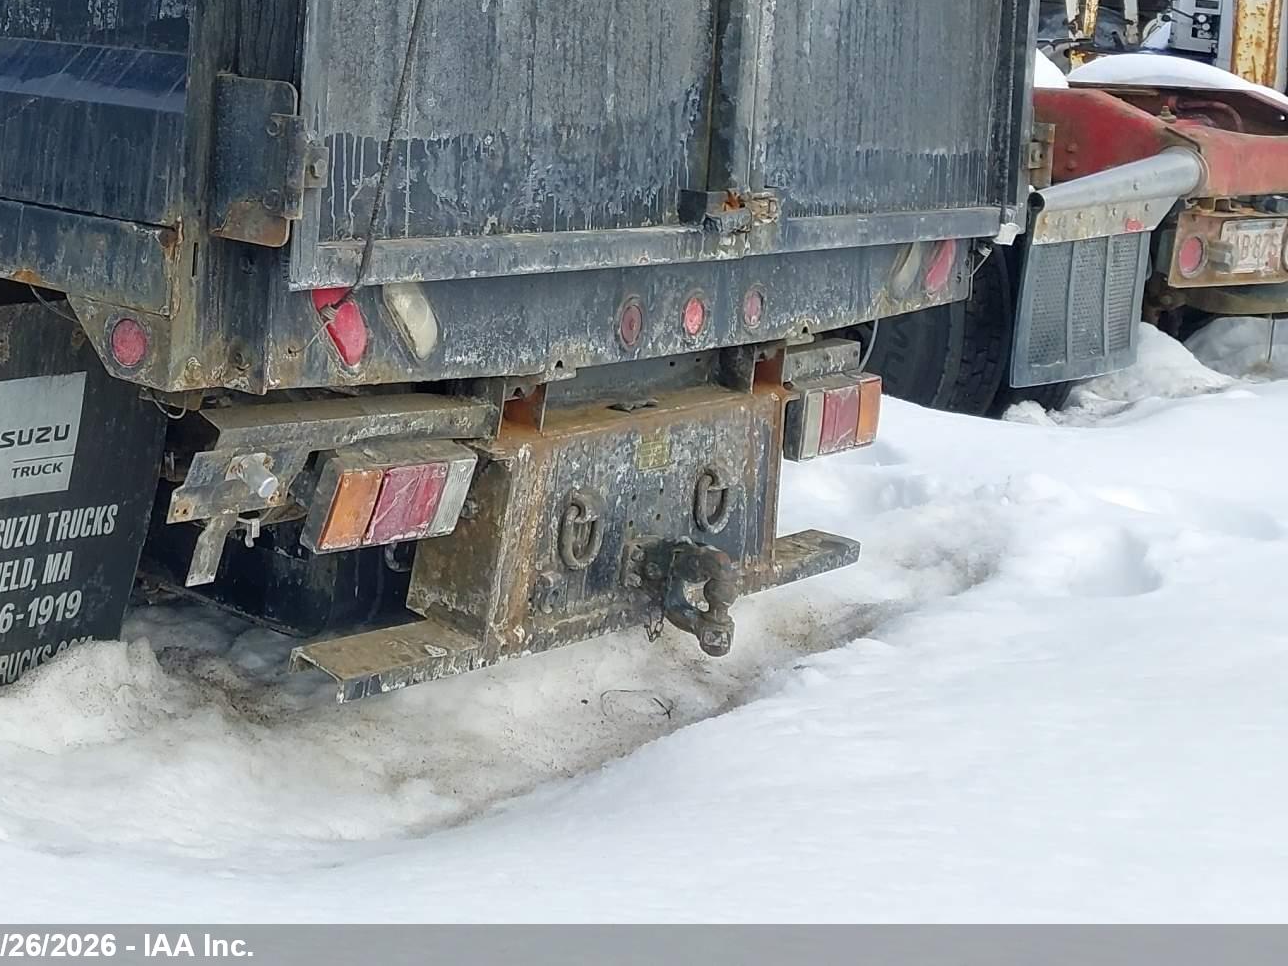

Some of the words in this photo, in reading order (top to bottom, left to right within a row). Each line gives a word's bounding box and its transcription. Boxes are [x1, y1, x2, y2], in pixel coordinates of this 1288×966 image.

[11, 462, 63, 479] TRUCK
[45, 504, 118, 542] TRUCKS
[42, 551, 73, 585] MA
